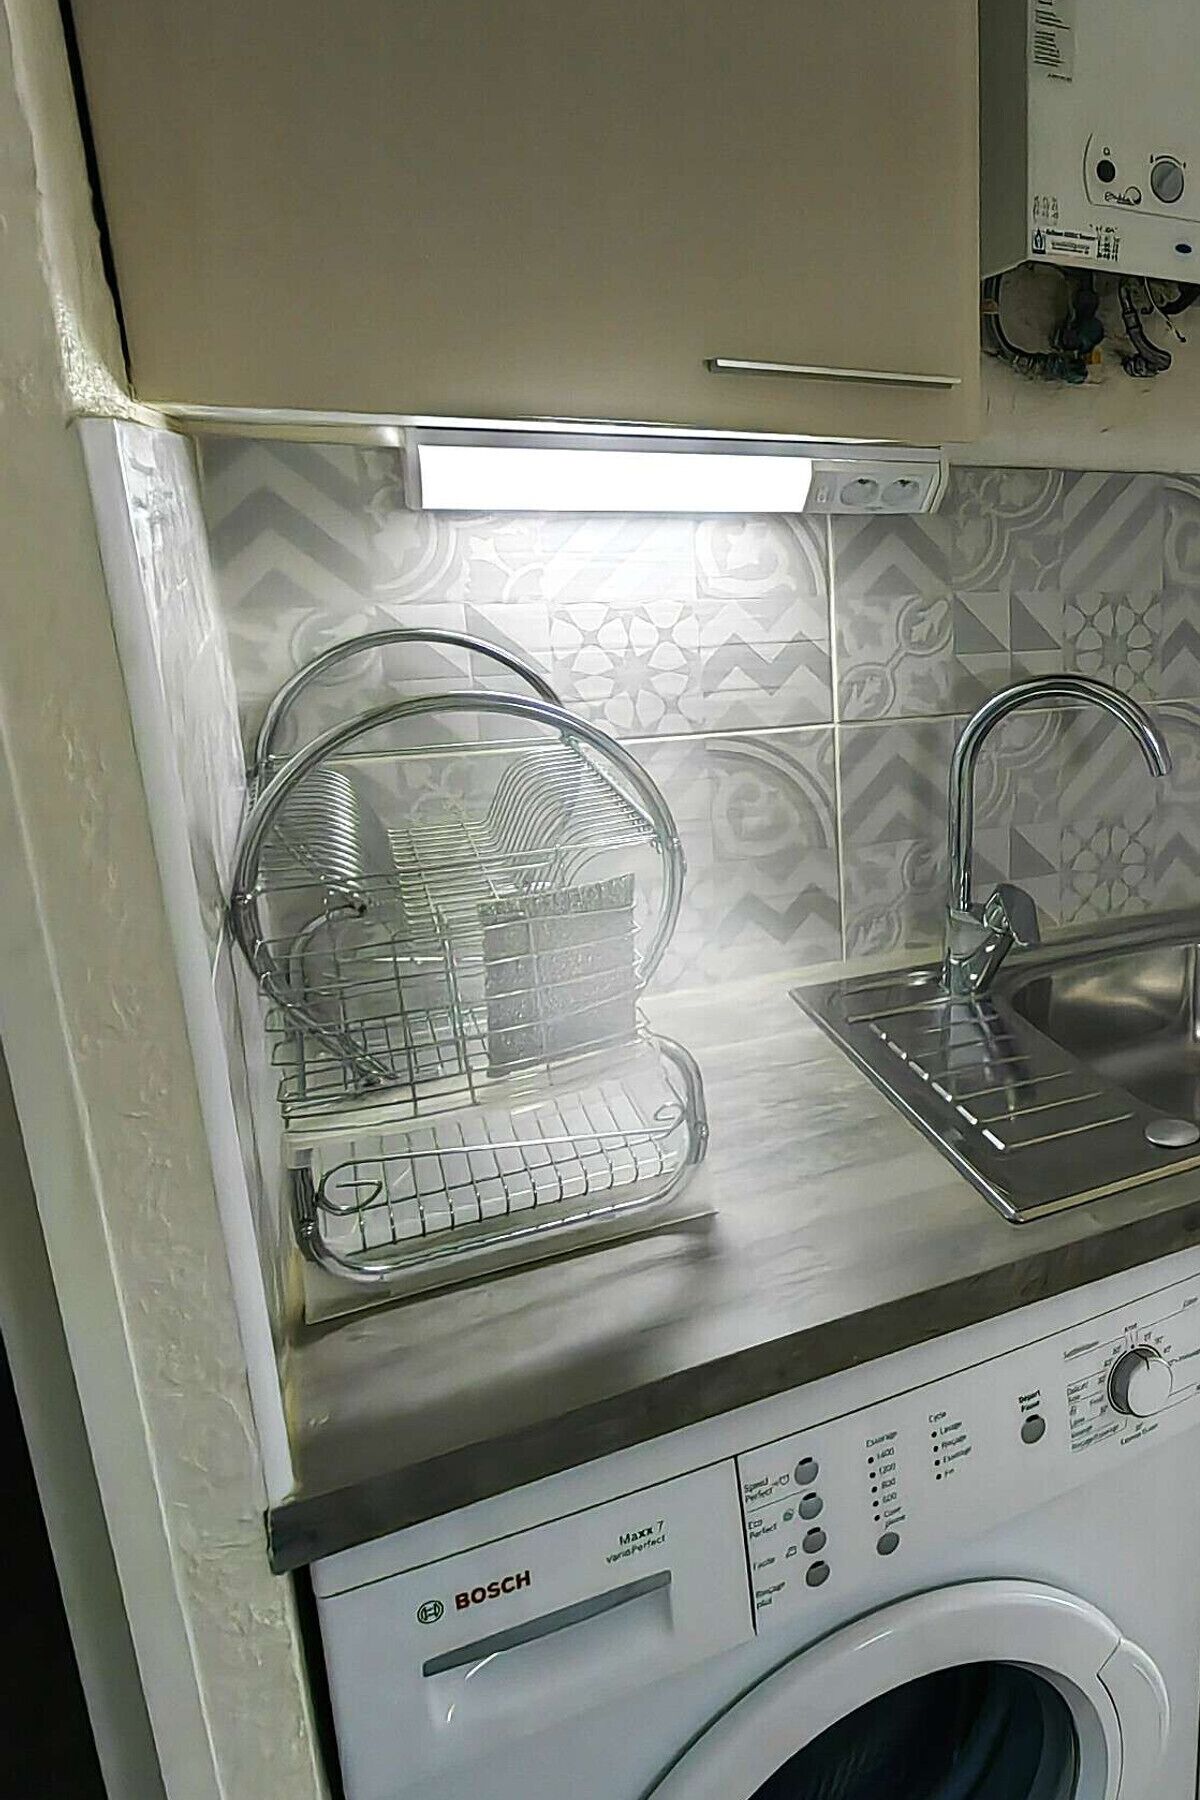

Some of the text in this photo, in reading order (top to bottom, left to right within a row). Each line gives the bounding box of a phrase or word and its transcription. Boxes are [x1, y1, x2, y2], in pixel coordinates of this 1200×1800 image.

[619, 1521, 665, 1545] Maxx 7
[454, 1569, 532, 1611] BOSCH
